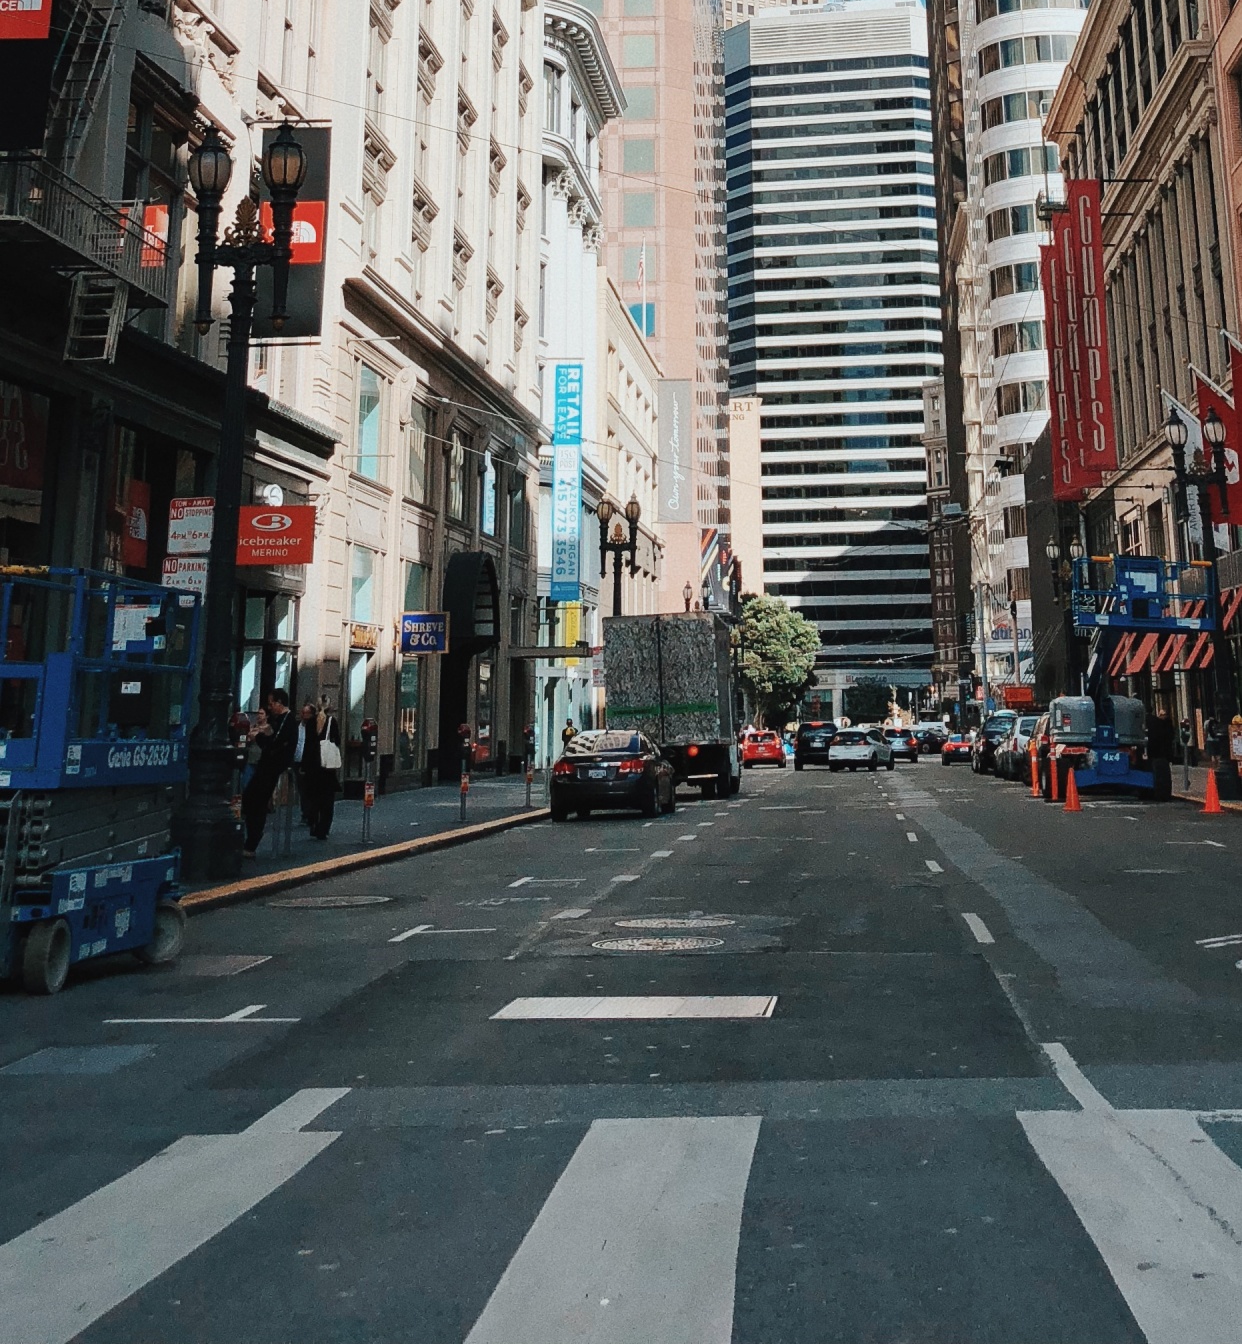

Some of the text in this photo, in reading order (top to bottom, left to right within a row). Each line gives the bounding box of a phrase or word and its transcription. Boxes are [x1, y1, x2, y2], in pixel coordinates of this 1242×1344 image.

[1078, 195, 1106, 452] GUMPS
[556, 368, 567, 440] FOR LEASE
[566, 367, 580, 440] RETAIL
[667, 391, 686, 510] Own your tomorrow
[170, 508, 213, 519] NO STOPPING
[567, 477, 577, 576] KAZUKO MORGAN
[239, 536, 302, 547] icebreaker
[251, 548, 289, 557] MERINO
[164, 559, 206, 573] NO PARKING
[404, 619, 445, 633] SHREVE
[409, 633, 421, 646] &
[108, 746, 132, 769] Genie
[133, 745, 170, 767] GS-2632
[1102, 752, 1121, 762] 4x4
